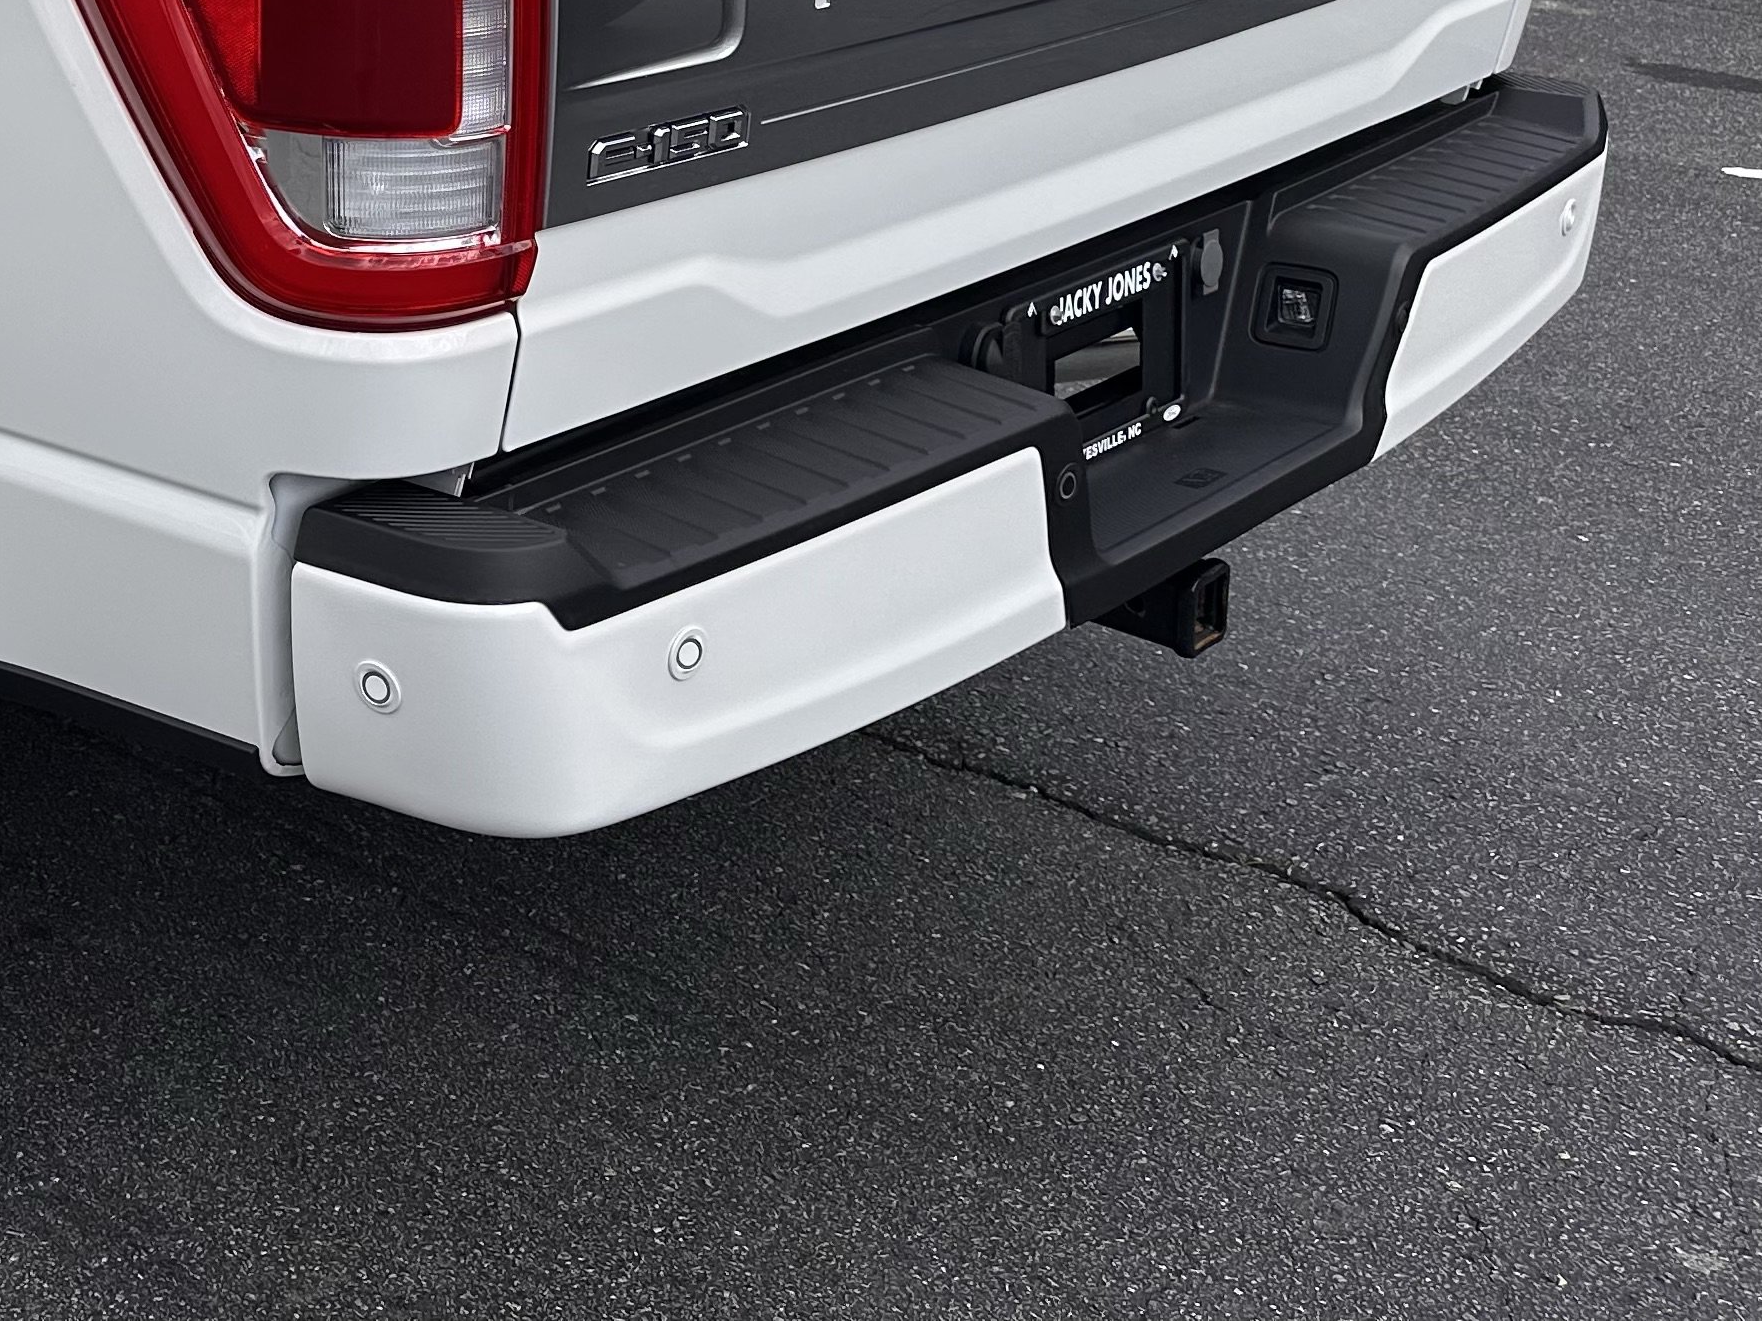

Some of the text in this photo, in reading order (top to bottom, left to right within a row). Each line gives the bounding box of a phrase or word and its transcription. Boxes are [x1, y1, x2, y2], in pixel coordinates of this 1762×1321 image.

[586, 105, 752, 186] F-150
[1056, 261, 1151, 326] JACKY JONES
[1127, 422, 1142, 440] NC
